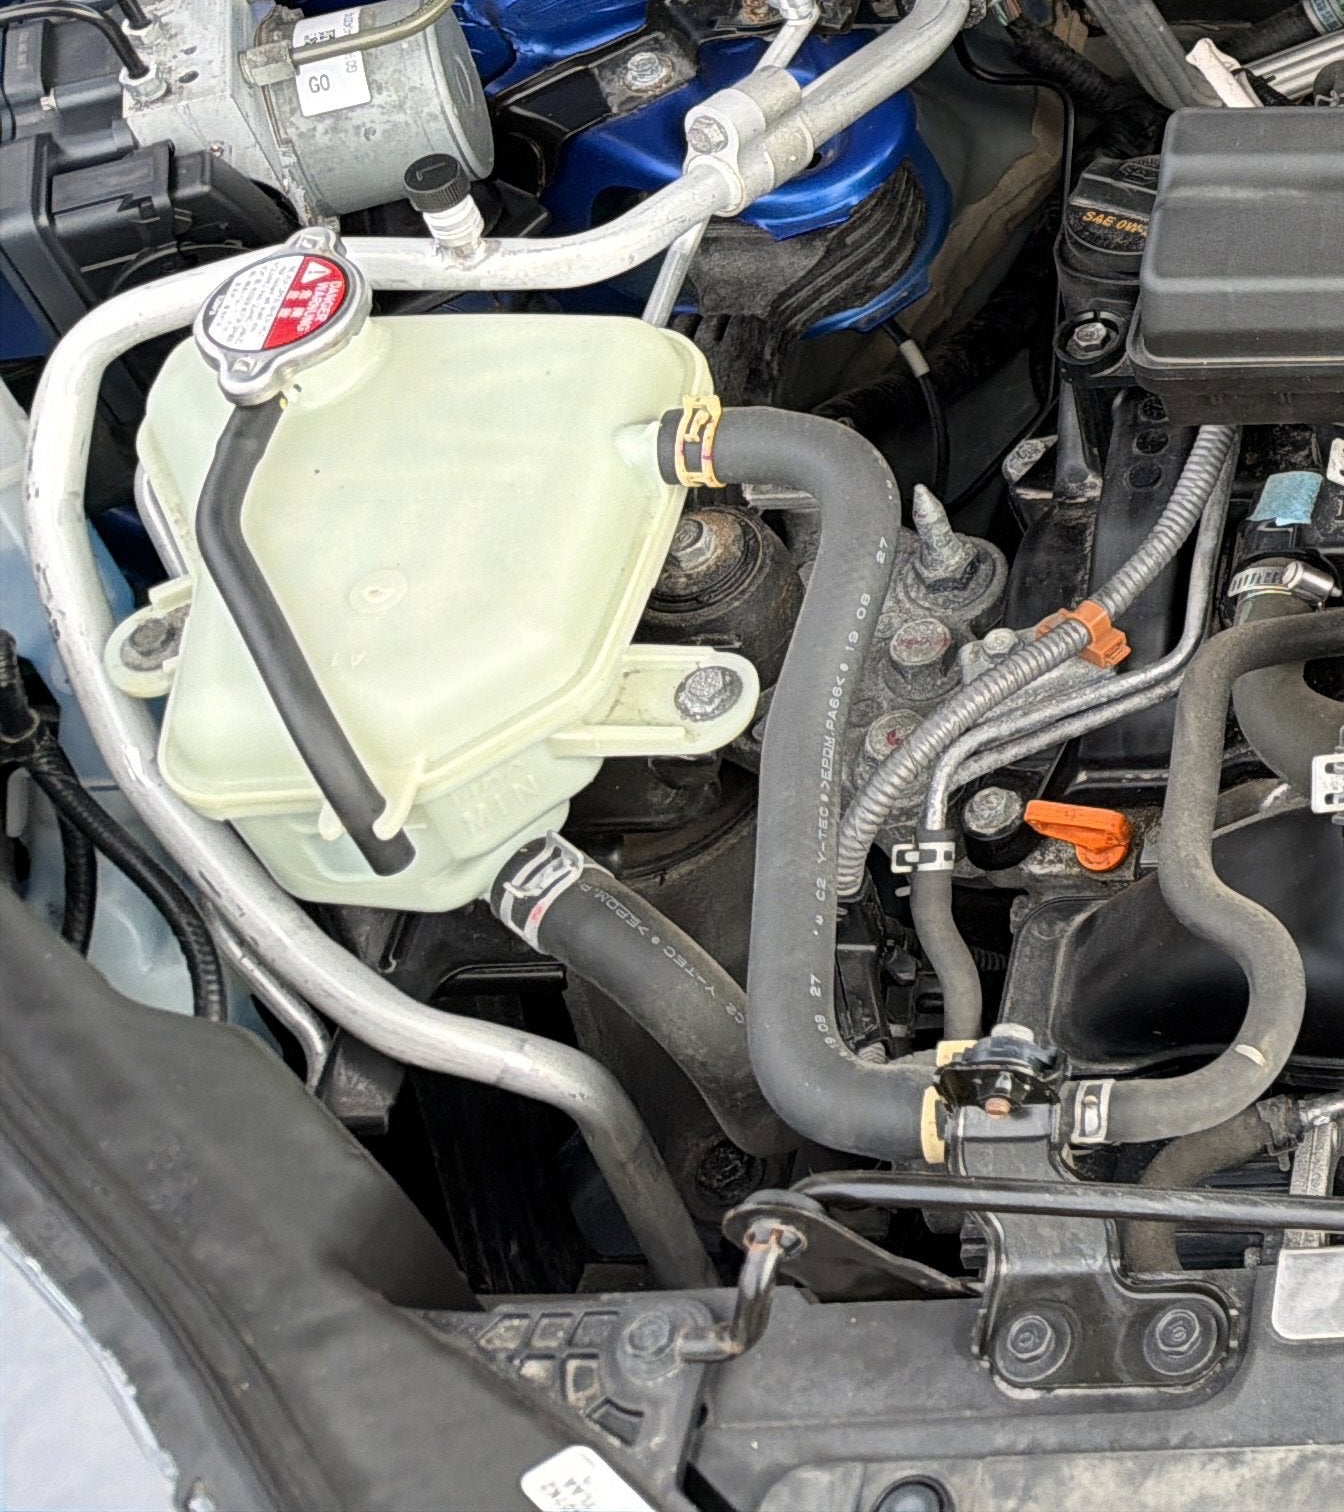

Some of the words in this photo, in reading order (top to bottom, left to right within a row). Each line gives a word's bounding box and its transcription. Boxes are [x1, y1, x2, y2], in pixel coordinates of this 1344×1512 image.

[1082, 211, 1117, 228] SAE
[816, 806, 830, 865] Y-TEC
[875, 535, 889, 564] 27
[662, 945, 717, 998] Y-TEC
[809, 973, 822, 998] 27
